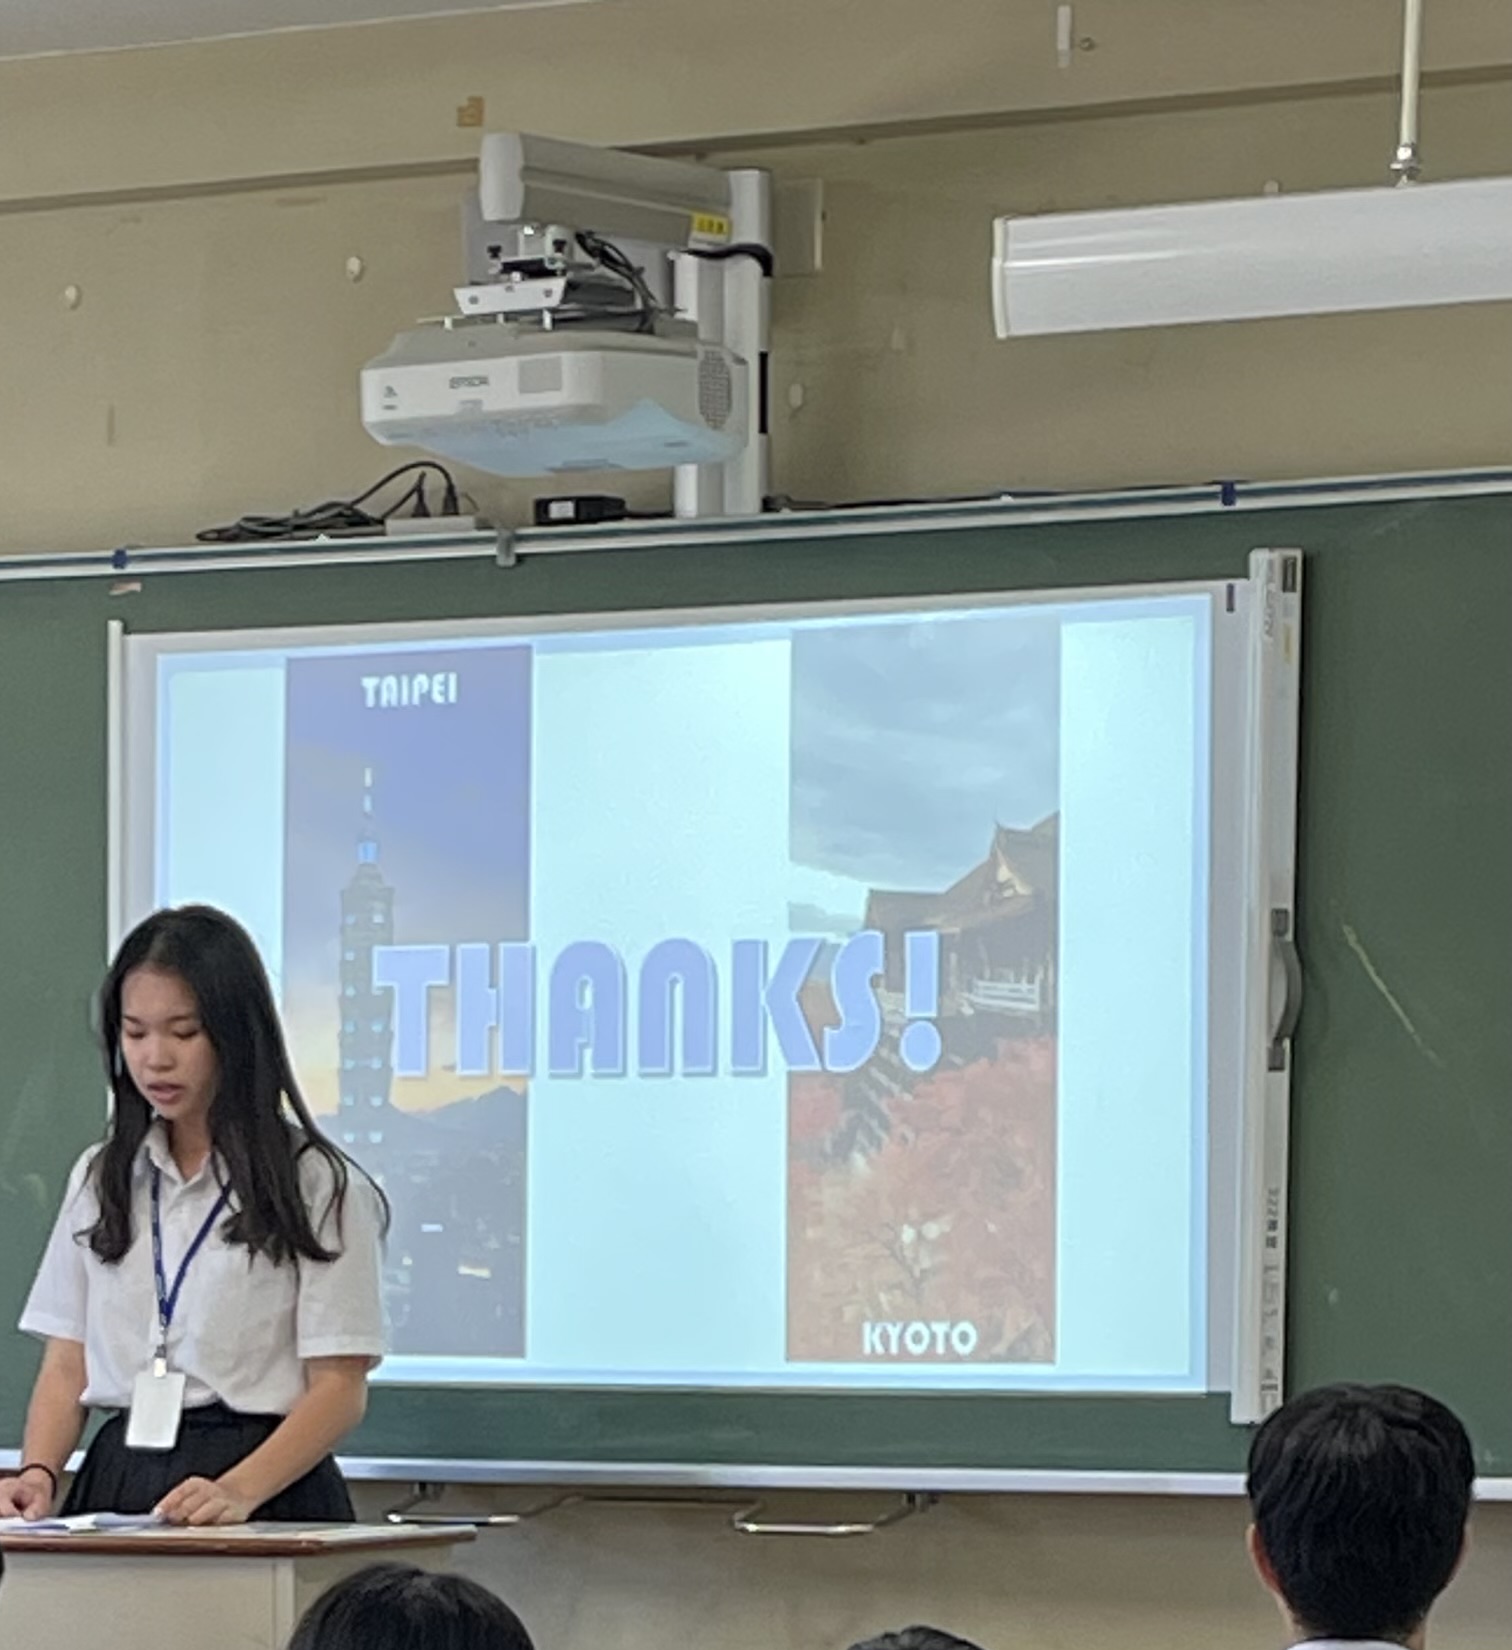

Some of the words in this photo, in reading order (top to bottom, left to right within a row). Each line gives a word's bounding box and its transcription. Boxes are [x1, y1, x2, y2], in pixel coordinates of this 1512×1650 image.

[361, 671, 458, 709] TAIPEI
[372, 930, 942, 1078] THANKS!
[862, 1319, 978, 1356] KYOTO
